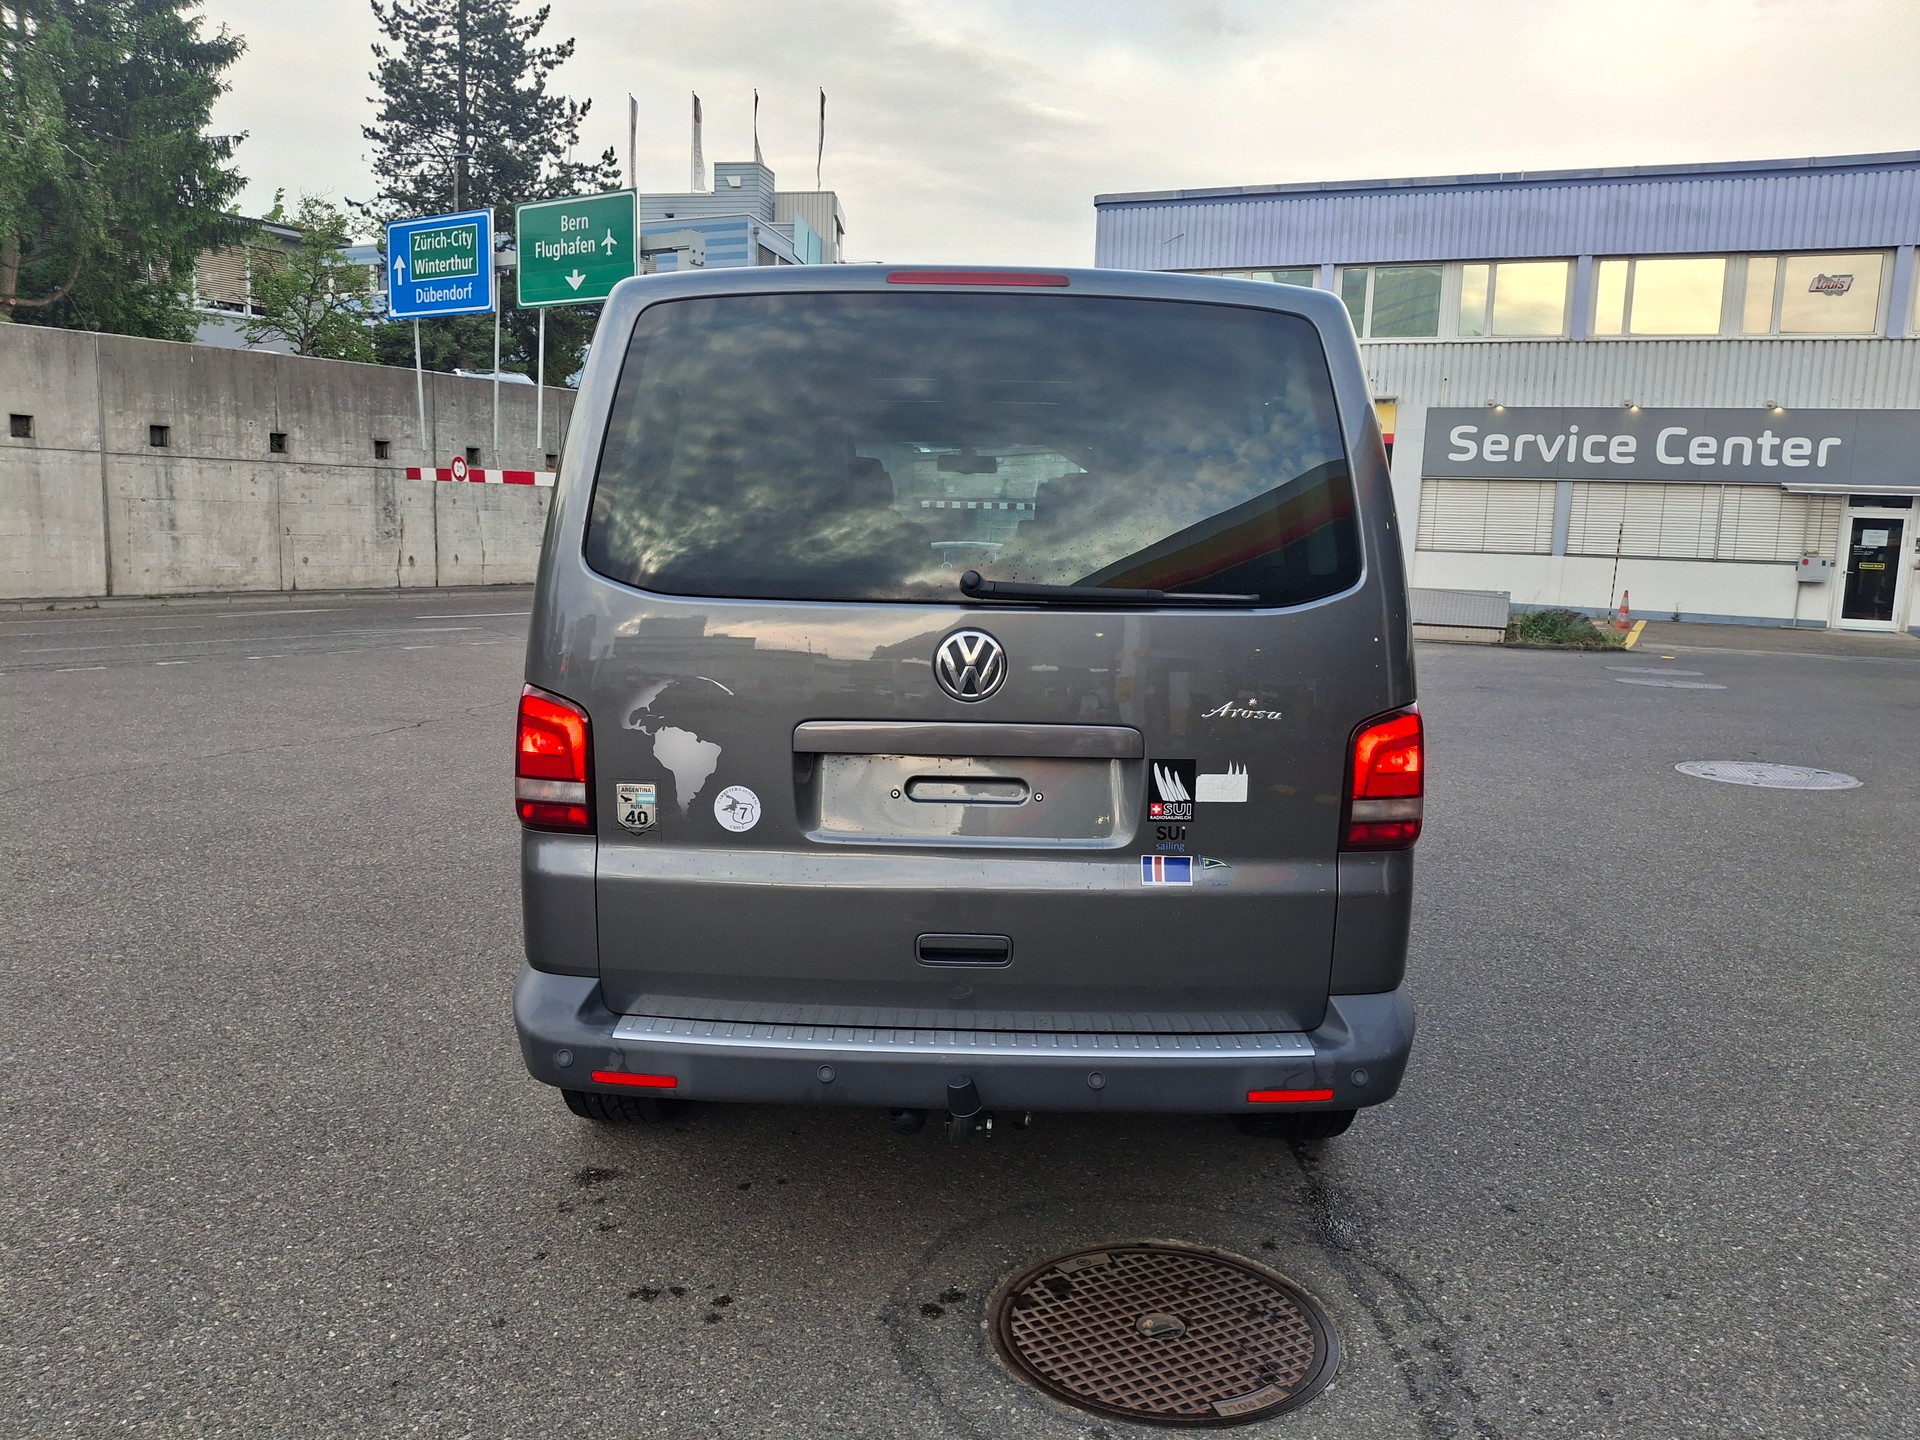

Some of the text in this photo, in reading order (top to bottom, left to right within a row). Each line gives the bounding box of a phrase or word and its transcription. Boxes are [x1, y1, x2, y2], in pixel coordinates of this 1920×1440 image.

[560, 215, 589, 232] Bern
[414, 231, 473, 252] Zürich-City
[535, 236, 595, 261] Flughafen
[414, 255, 474, 275] Winterthur
[415, 282, 473, 303] Dübendorf
[1448, 425, 1842, 468] Service Center
[1201, 701, 1283, 720] Arosa
[625, 810, 648, 825] 40
[739, 807, 748, 820] 7
[1163, 803, 1192, 816] SUI
[1155, 841, 1185, 852] sailing
